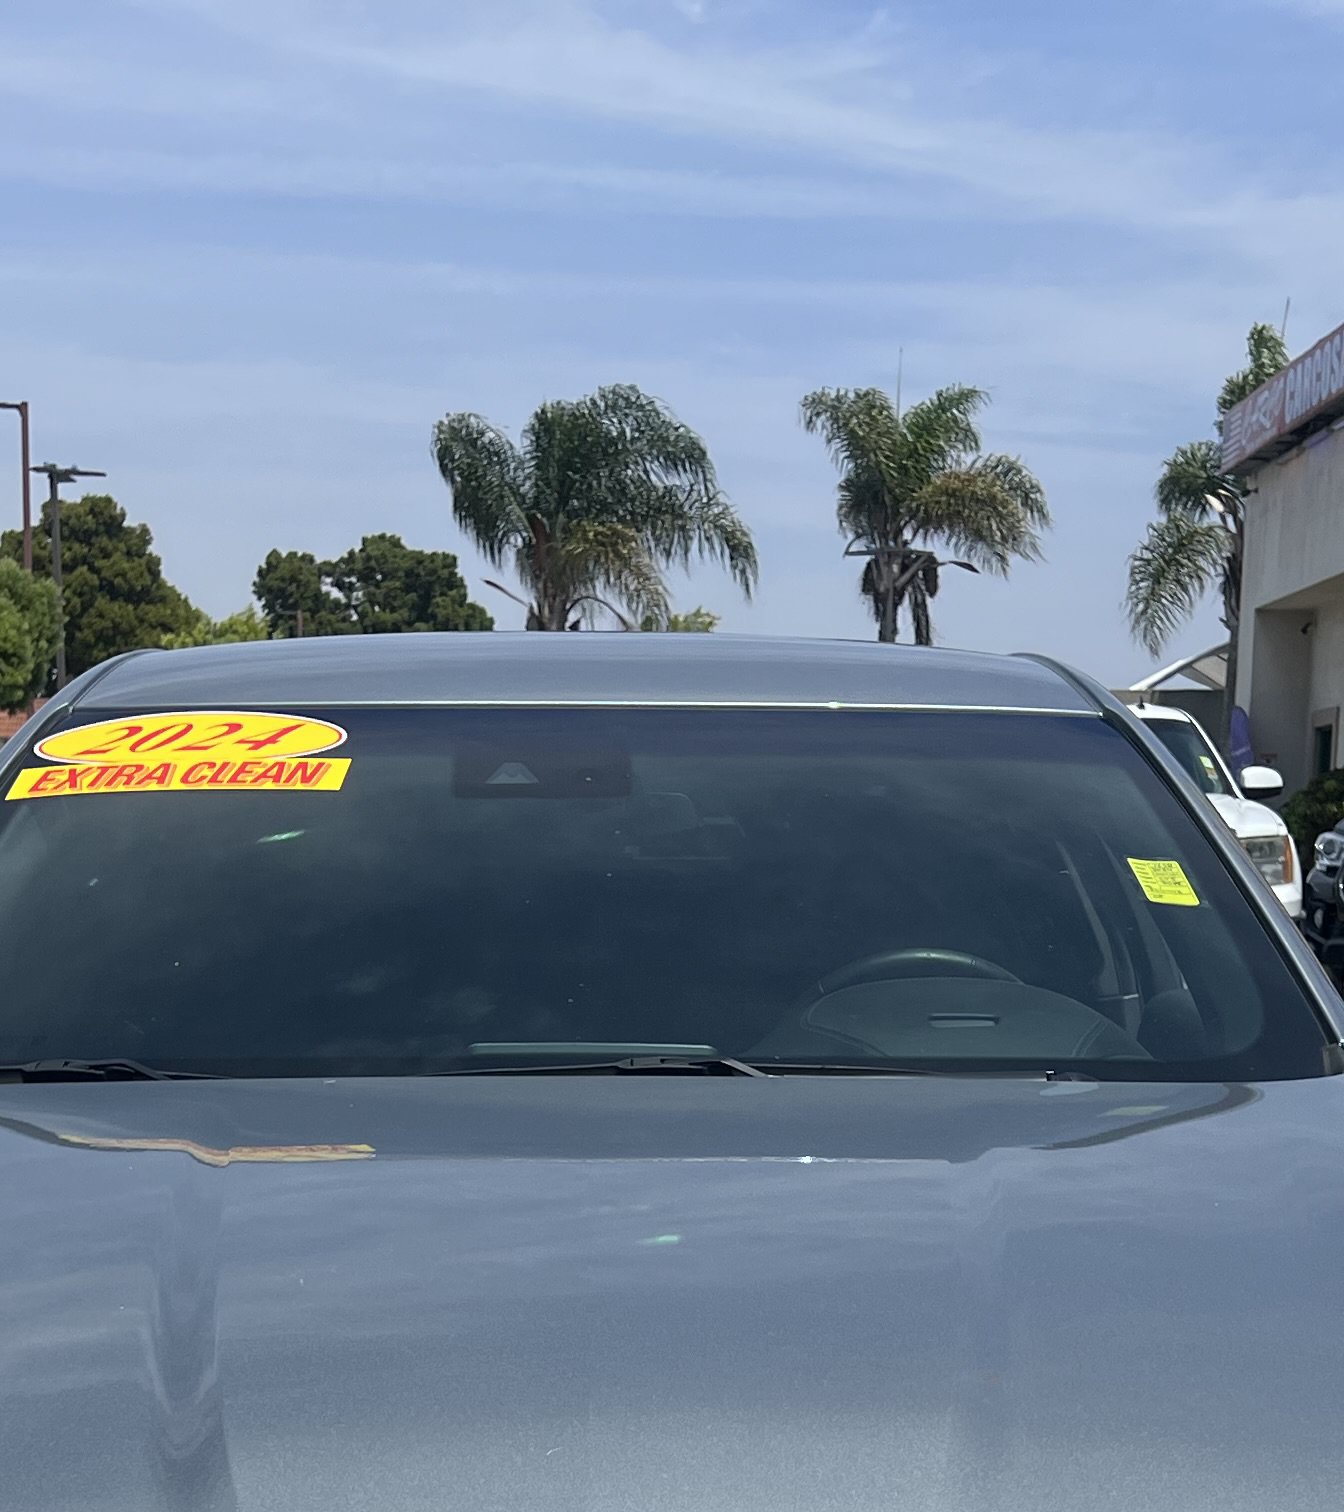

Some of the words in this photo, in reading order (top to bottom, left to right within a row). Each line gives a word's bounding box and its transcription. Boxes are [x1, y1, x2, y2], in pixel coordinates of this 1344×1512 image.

[71, 722, 308, 757] 2024
[26, 763, 178, 796] EXTRA
[179, 760, 333, 788] CLEAN
